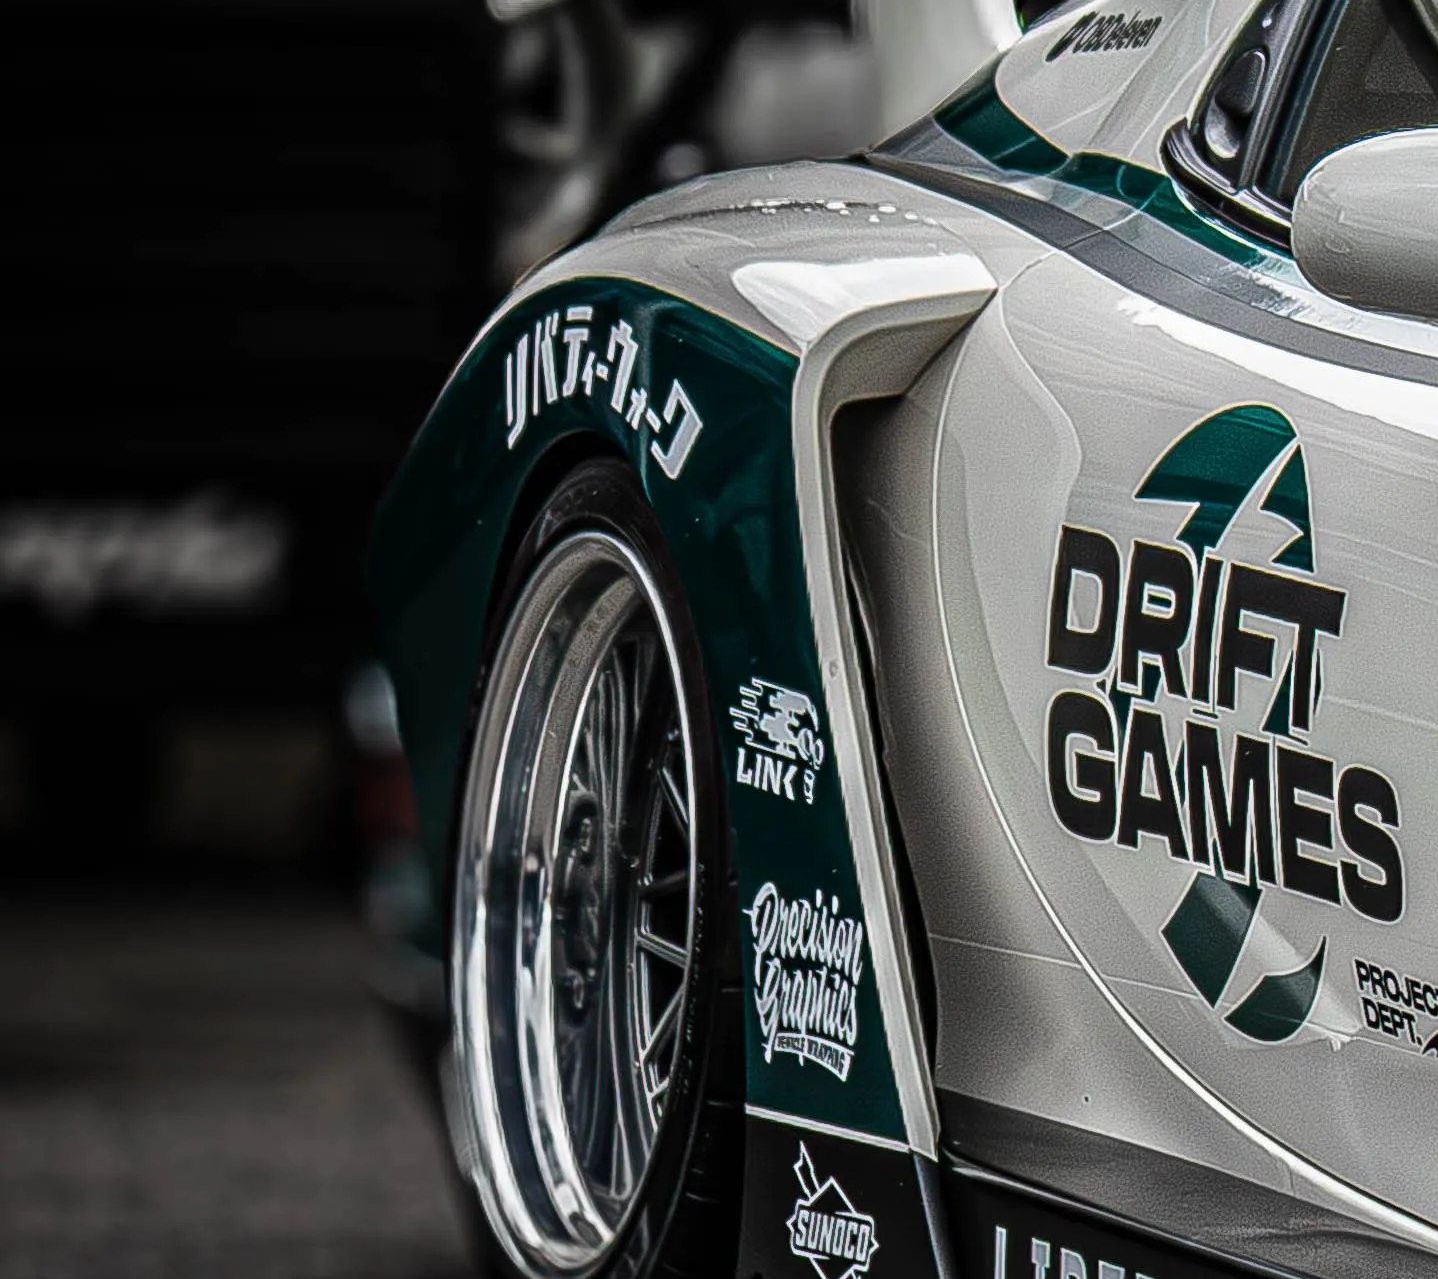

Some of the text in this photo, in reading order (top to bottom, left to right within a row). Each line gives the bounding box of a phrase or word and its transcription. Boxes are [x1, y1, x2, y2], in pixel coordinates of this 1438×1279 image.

[1046, 524, 1347, 732] DRIFT
[736, 746, 798, 802] LINK
[1048, 691, 1405, 924] GAMES
[742, 882, 863, 986] Precision
[754, 957, 858, 1066] Graphics
[795, 1209, 871, 1262] SUNOCO
